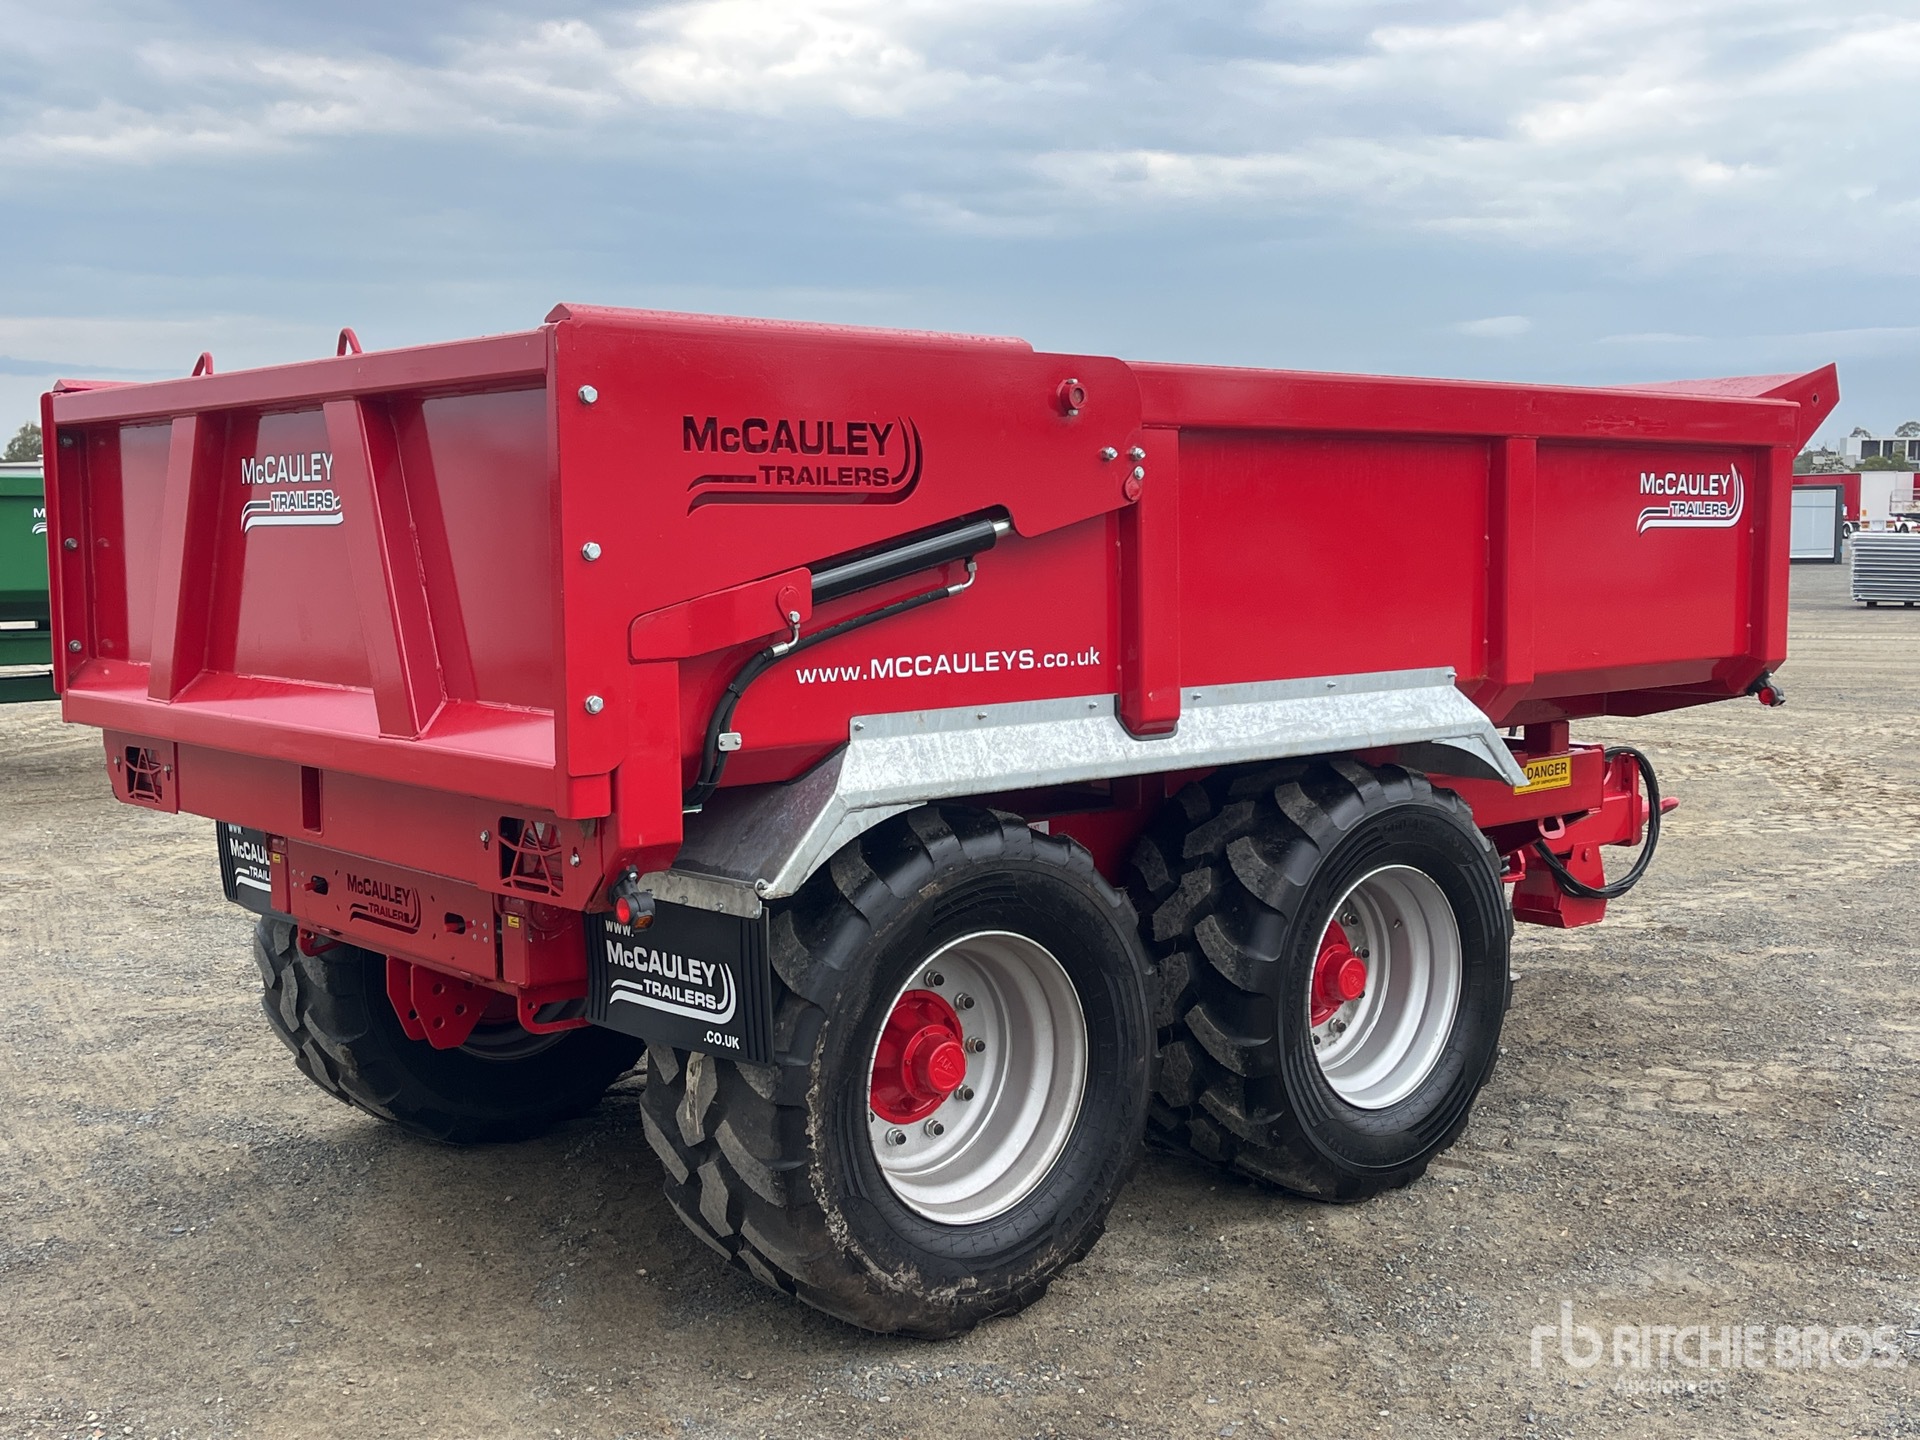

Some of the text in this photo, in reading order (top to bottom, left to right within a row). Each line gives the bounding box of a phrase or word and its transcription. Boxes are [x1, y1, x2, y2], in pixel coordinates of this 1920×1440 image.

[682, 415, 894, 456] McCAULEY
[241, 452, 333, 485] McCAULEY
[758, 465, 890, 487] TRAILERS
[1639, 472, 1731, 496] McCAULEY
[271, 490, 334, 512] TRAILERS
[1670, 501, 1729, 517] TRAILERS
[796, 647, 1101, 684] www.MCCAULEYS.co.uk
[1527, 762, 1567, 780] DANGER
[229, 837, 271, 866] McCAUL
[248, 865, 272, 882] TRAIL
[346, 873, 411, 907] McCAULEY
[605, 939, 716, 988] McCAULEY
[643, 978, 717, 1010] TRAILERS
[703, 1030, 741, 1050] .CO.UK
